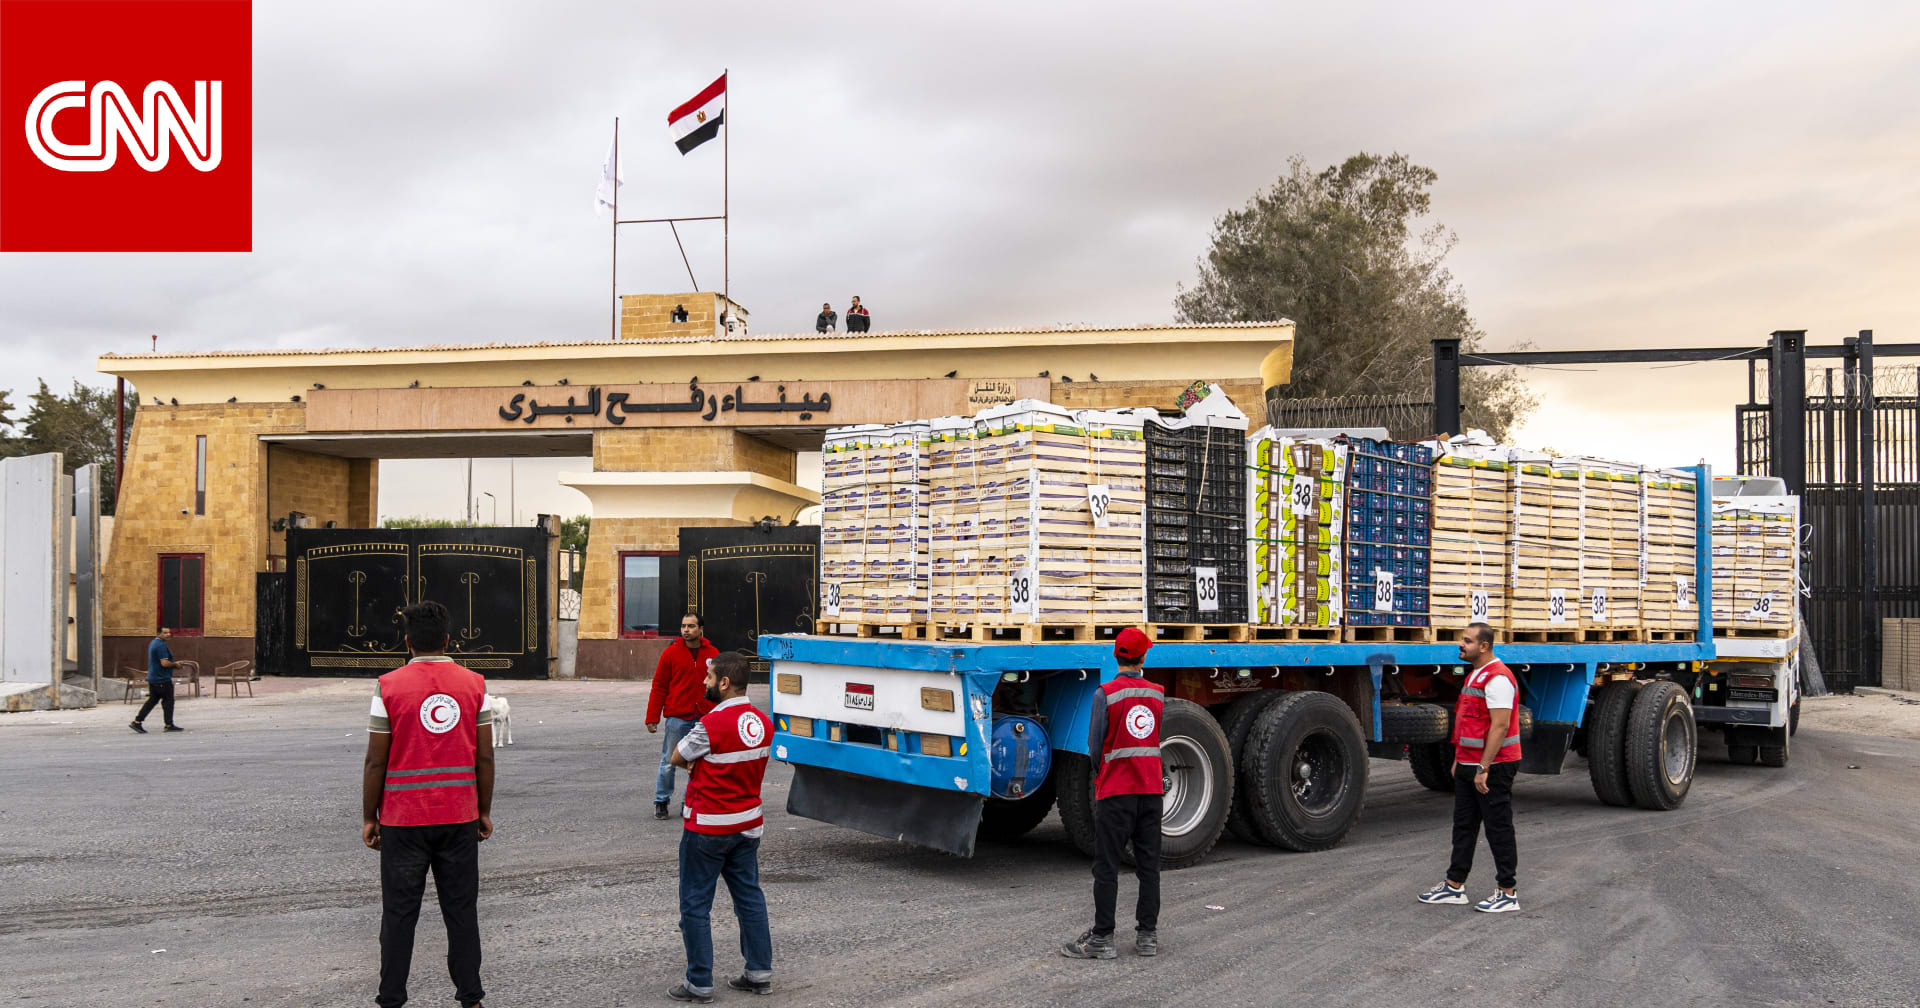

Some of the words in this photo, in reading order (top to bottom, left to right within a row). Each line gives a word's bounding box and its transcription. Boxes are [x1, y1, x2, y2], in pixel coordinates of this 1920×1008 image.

[606, 383, 717, 425] رفح
[721, 385, 831, 420] ميناء
[1293, 483, 1311, 507] 38
[829, 584, 840, 606] 38
[1012, 577, 1029, 603] 38
[1198, 576, 1216, 600] 38
[1377, 580, 1391, 602] 38
[1473, 595, 1487, 616] 38
[1551, 596, 1564, 616] 38
[1593, 596, 1605, 614] 38
[1753, 598, 1770, 612] 38
